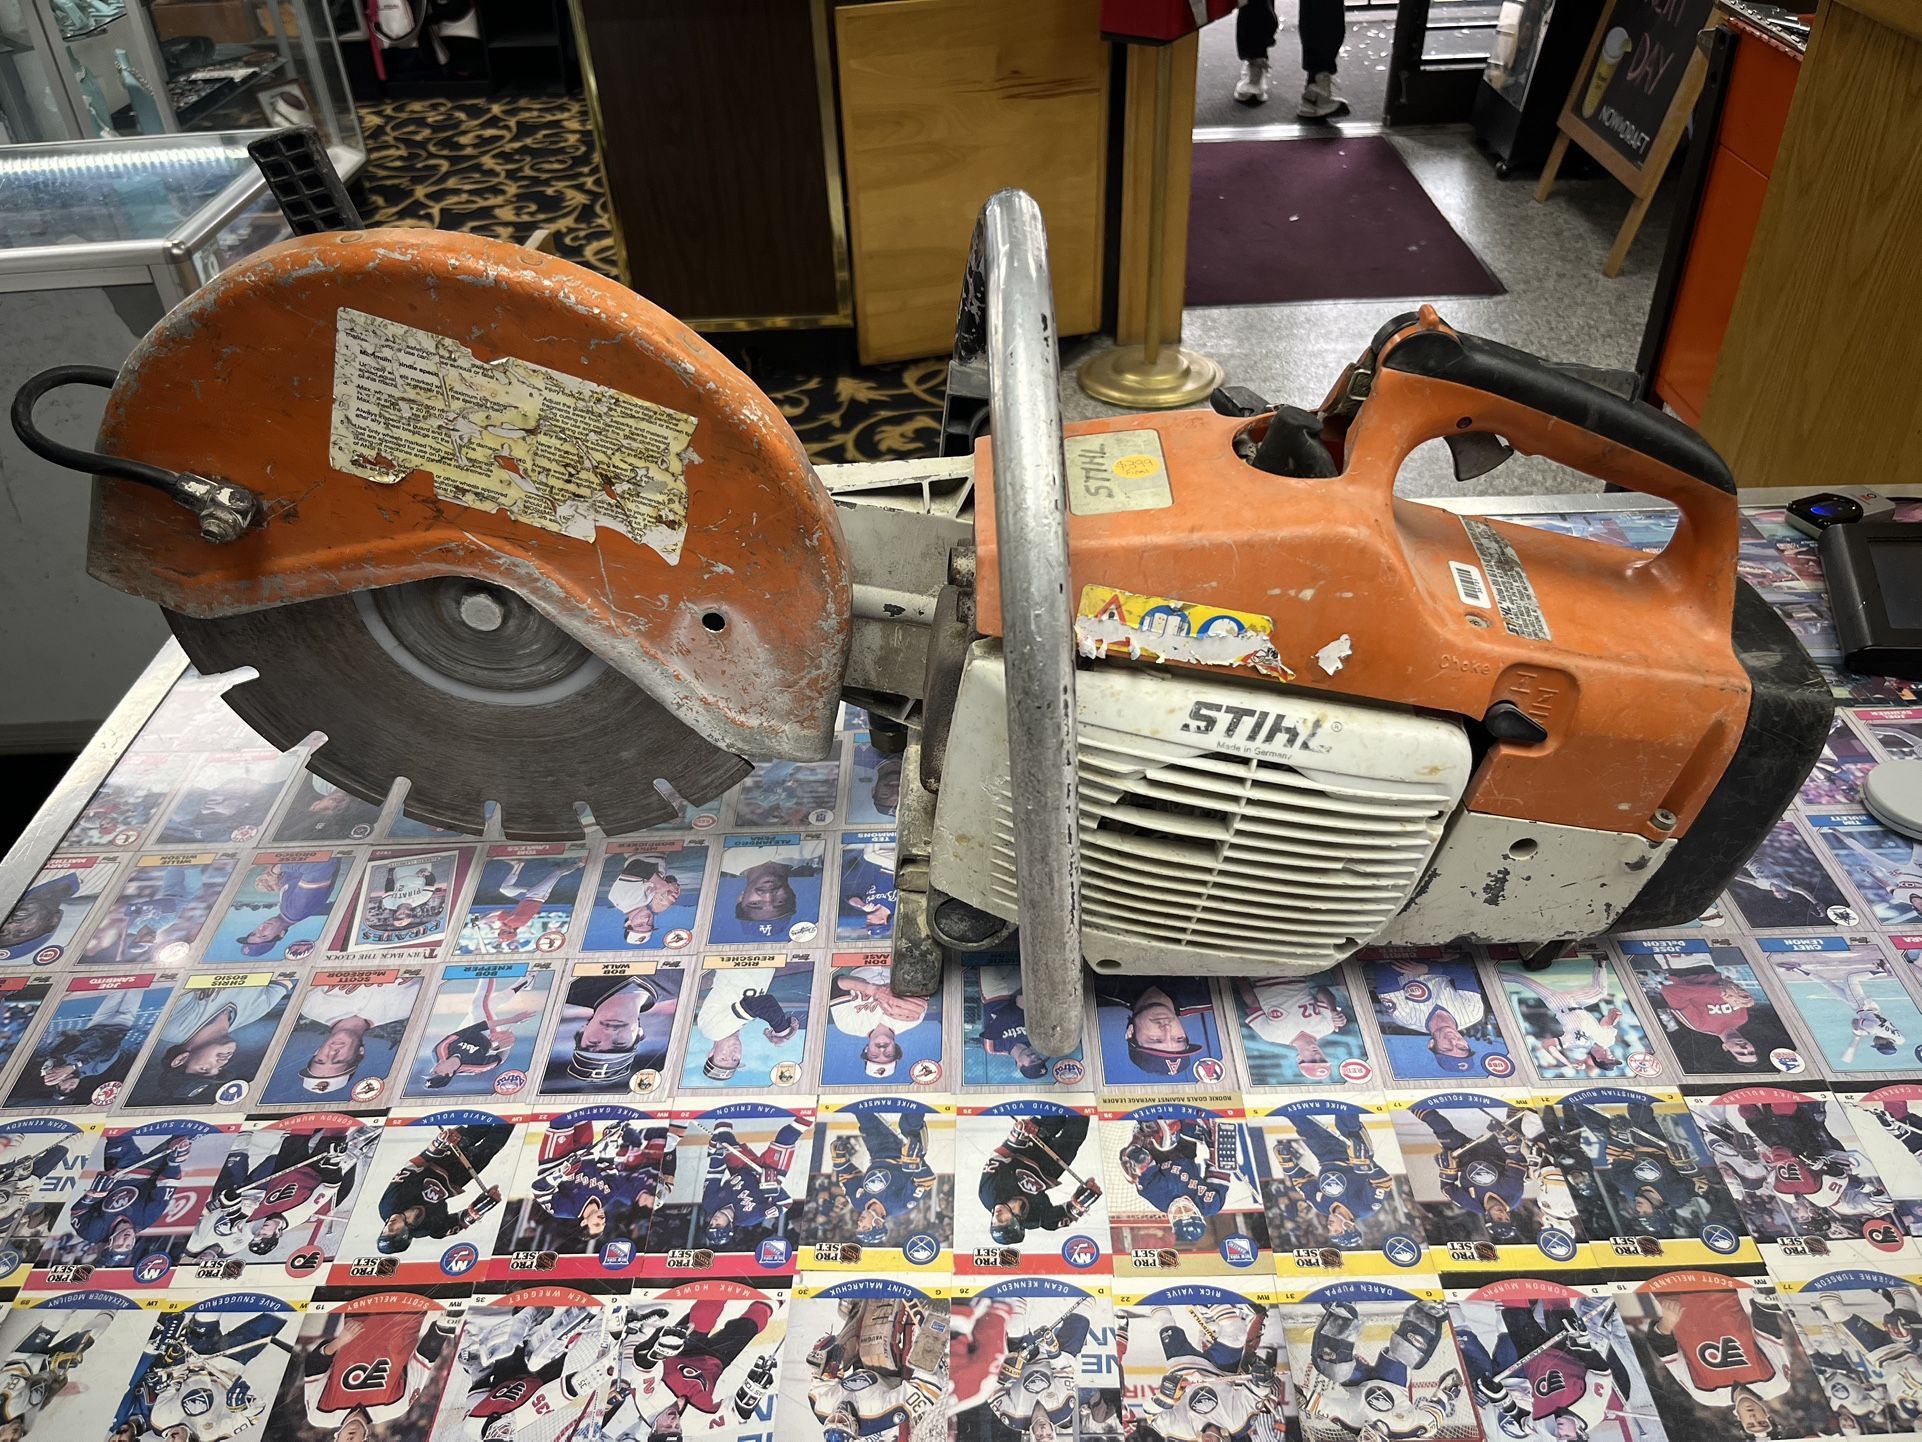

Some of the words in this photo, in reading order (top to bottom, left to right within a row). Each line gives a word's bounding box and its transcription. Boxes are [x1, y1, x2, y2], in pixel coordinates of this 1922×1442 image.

[1078, 443, 1114, 498] STIHL
[481, 486, 508, 498] approved
[1439, 654, 1490, 674] Choke
[1180, 700, 1332, 754] STIHL
[1216, 741, 1242, 752] Made
[1244, 745, 1252, 754] in
[1254, 748, 1292, 760] Germany
[362, 921, 441, 942] PIRATES
[759, 924, 772, 936] LA
[1784, 938, 1823, 946] LEMON
[407, 948, 437, 959] TURN
[464, 965, 513, 973] KNEPPER
[338, 976, 371, 984] SCOTT
[1427, 1093, 1462, 1106] FOLIGNO
[1465, 1095, 1490, 1105] MIKE
[1568, 1090, 1597, 1103] RUUTTU
[1599, 1088, 1647, 1102] CHRISTIAN
[1722, 1089, 1771, 1103] BULLARD
[1773, 1089, 1800, 1100] MIKE
[858, 1098, 891, 1109] RAMSEY
[895, 1099, 916, 1109] MIKE
[992, 1102, 1024, 1115] VOLEK
[1032, 1102, 1063, 1114] DAVID
[1287, 1100, 1320, 1112] RAMSEY
[1324, 1101, 1347, 1111] MIKE
[566, 1107, 610, 1120] GARTNER
[614, 1108, 640, 1119] MIKE
[716, 1104, 752, 1116] ERIXON
[756, 1105, 776, 1115] JAN
[1133, 1106, 1172, 1118] RICHTER
[1180, 1106, 1205, 1117] MIKE
[278, 1114, 315, 1128] MURPHY
[422, 1112, 455, 1124] VOLEK
[460, 1112, 492, 1123] DAVID
[6, 1120, 45, 1130] KENNEDY
[47, 1121, 67, 1130] DEAN
[135, 1122, 174, 1134] SUTTER
[178, 1122, 209, 1133] BRENT
[817, 1243, 839, 1251] SET
[1449, 1242, 1472, 1251] SET
[1611, 1237, 1635, 1246] SET
[1779, 1237, 1801, 1246] SET
[513, 1251, 536, 1260] SET
[669, 1250, 692, 1259] SET
[974, 1248, 997, 1257] SET
[1133, 1249, 1155, 1258] SET
[1295, 1249, 1318, 1258] SET
[1452, 1251, 1475, 1260] PRO
[1615, 1246, 1639, 1255] PRO
[1784, 1246, 1806, 1255] PRO
[816, 1252, 838, 1261] PRO
[975, 1257, 997, 1266] PRO
[1134, 1258, 1156, 1266] PRO
[1296, 1258, 1320, 1266] PRO
[200, 1260, 223, 1269] SET
[354, 1258, 378, 1267] SET
[511, 1260, 534, 1269] PRO
[668, 1259, 690, 1267] PRO
[52, 1265, 74, 1274] SET
[197, 1269, 220, 1278] PRO
[351, 1266, 374, 1276] PRO
[47, 1273, 70, 1282] PRO
[1648, 1274, 1695, 1291] MELLANBY
[1701, 1275, 1733, 1288] SCOTT
[1814, 1274, 1855, 1288] TURGEON
[1858, 1272, 1895, 1286] PIERRE
[675, 1283, 708, 1297] HOWE
[720, 1284, 750, 1297] MARK
[829, 1282, 882, 1296] MALARCHUK
[885, 1284, 912, 1297] CLINT
[996, 1281, 1038, 1294] KENNEDY
[1041, 1281, 1068, 1293] DEAN
[1324, 1285, 1354, 1297] PUPPA
[1360, 1284, 1392, 1297] DAREN
[1481, 1282, 1518, 1298] MURPHY
[1524, 1282, 1567, 1296] GORDON
[507, 1289, 561, 1304] WREGGET
[568, 1292, 587, 1304] KEN
[1166, 1288, 1194, 1298] VAIVE
[1198, 1288, 1221, 1298] RICK
[48, 1293, 86, 1307] MOGILNY
[89, 1293, 129, 1308] ALEXANDER
[198, 1295, 256, 1310] SNUGGERUD
[259, 1301, 281, 1310] DAVE
[347, 1295, 398, 1310] MELLANBY
[402, 1296, 430, 1310] SCOTT
